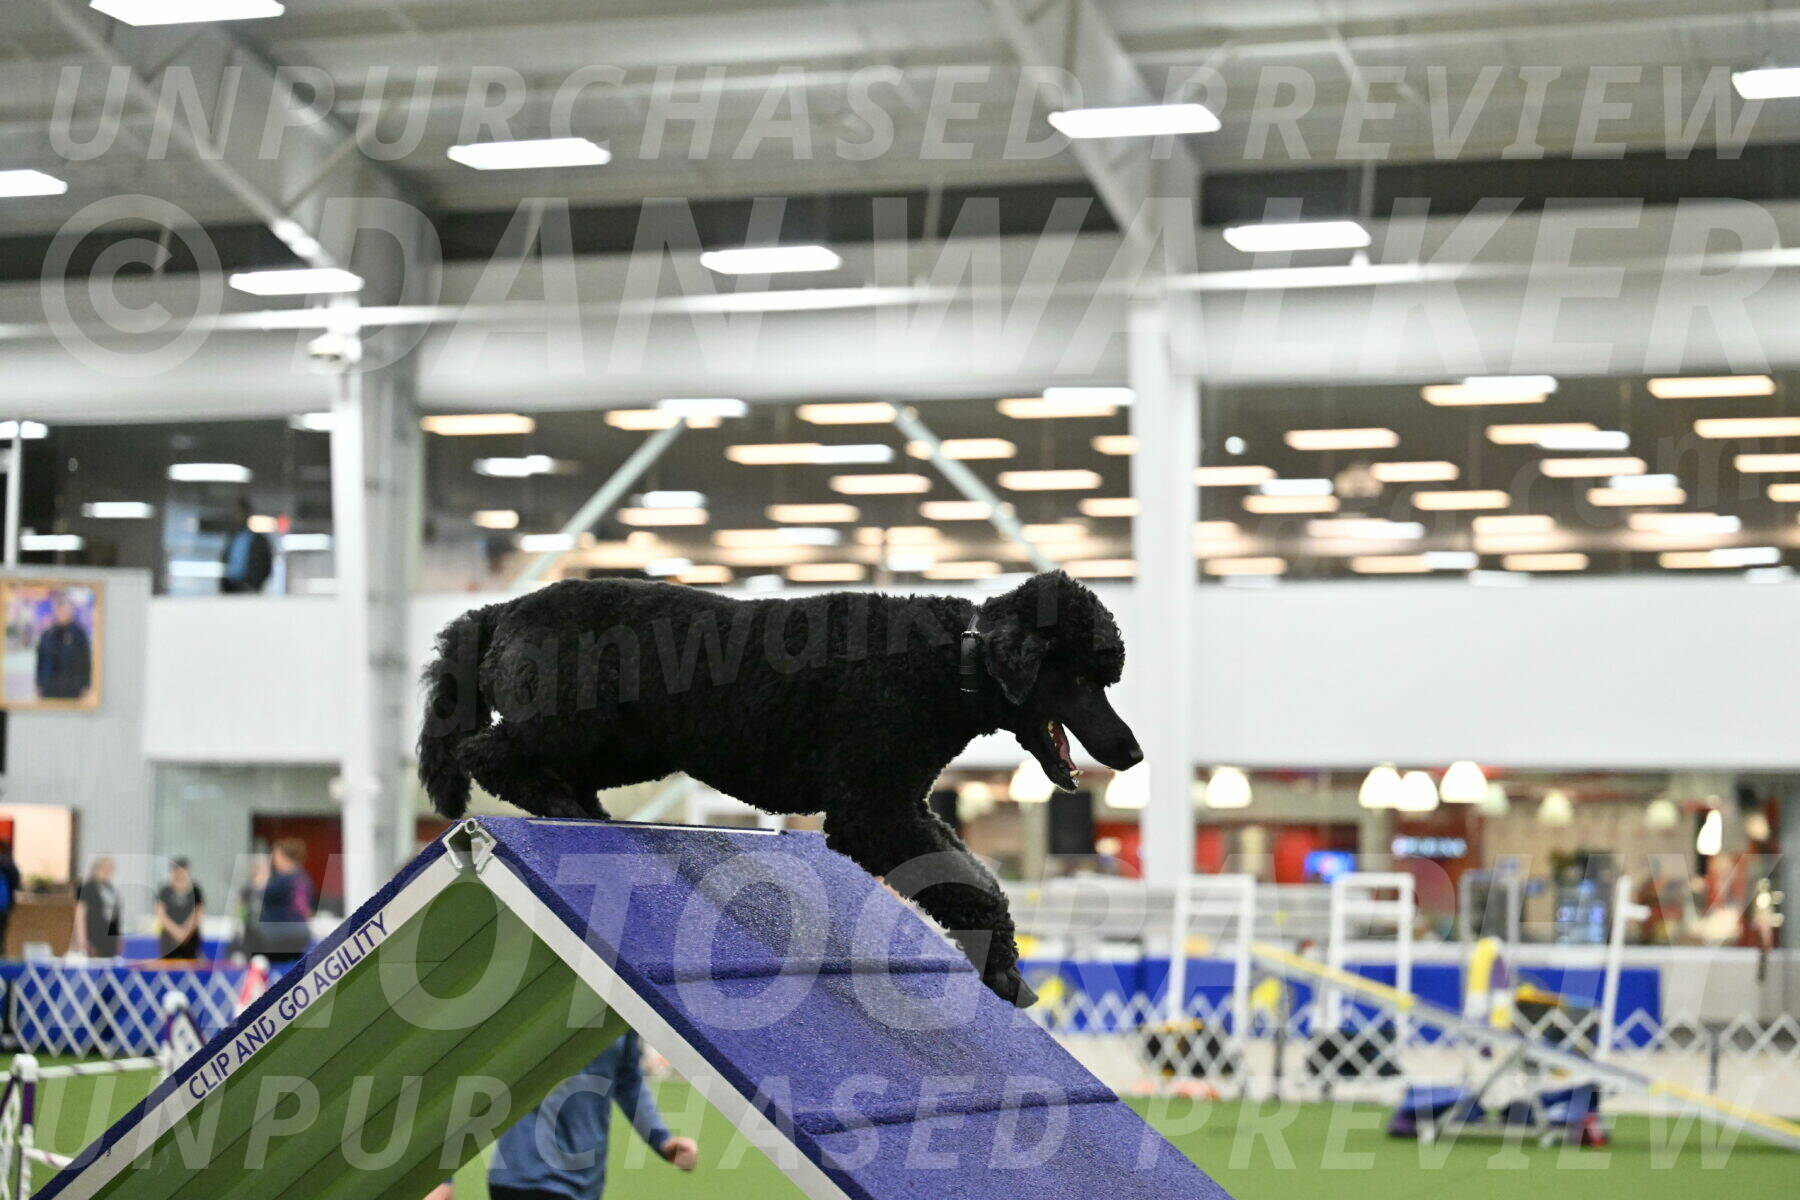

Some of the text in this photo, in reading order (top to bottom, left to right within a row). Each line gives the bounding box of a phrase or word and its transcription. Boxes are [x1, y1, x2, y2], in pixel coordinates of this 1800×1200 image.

[189, 912, 388, 1100] CLIP AND GO AGILITY
